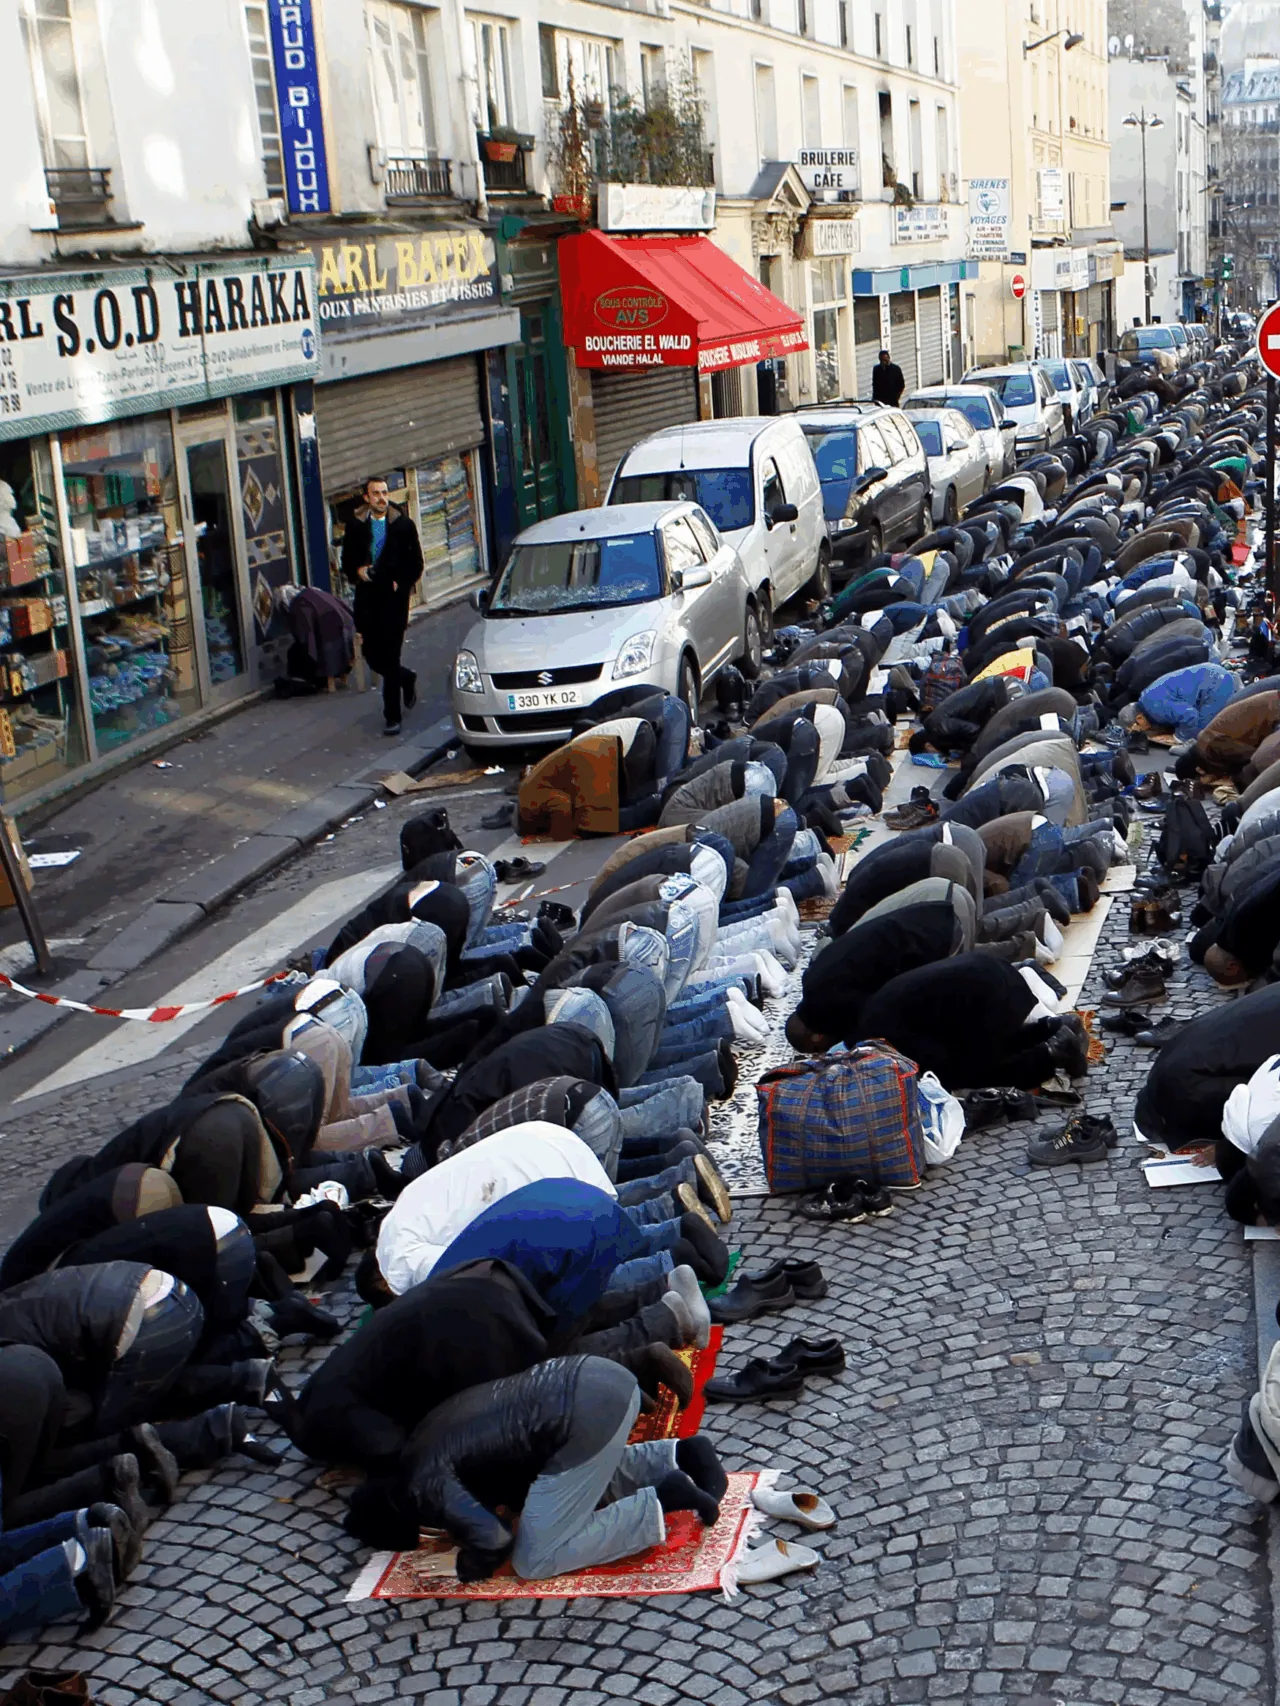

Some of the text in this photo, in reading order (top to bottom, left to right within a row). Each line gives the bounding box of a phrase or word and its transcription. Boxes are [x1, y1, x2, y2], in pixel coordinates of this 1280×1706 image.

[279, 0, 320, 212] AUD BIJOUX
[801, 152, 855, 166] BRULERIE
[814, 174, 843, 188] CAFE
[970, 180, 1008, 190] SIRENES
[970, 215, 1008, 225] VOYAGES
[316, 235, 491, 297] ARL BATEX
[450, 281, 493, 302] TISSUS
[174, 271, 311, 338] HARAKA
[615, 309, 649, 324] AVS
[585, 334, 690, 351] BOUCHERIE EL WALID
[602, 353, 664, 365] VIANDE HALAL
[518, 691, 577, 708] 330 YK 02
